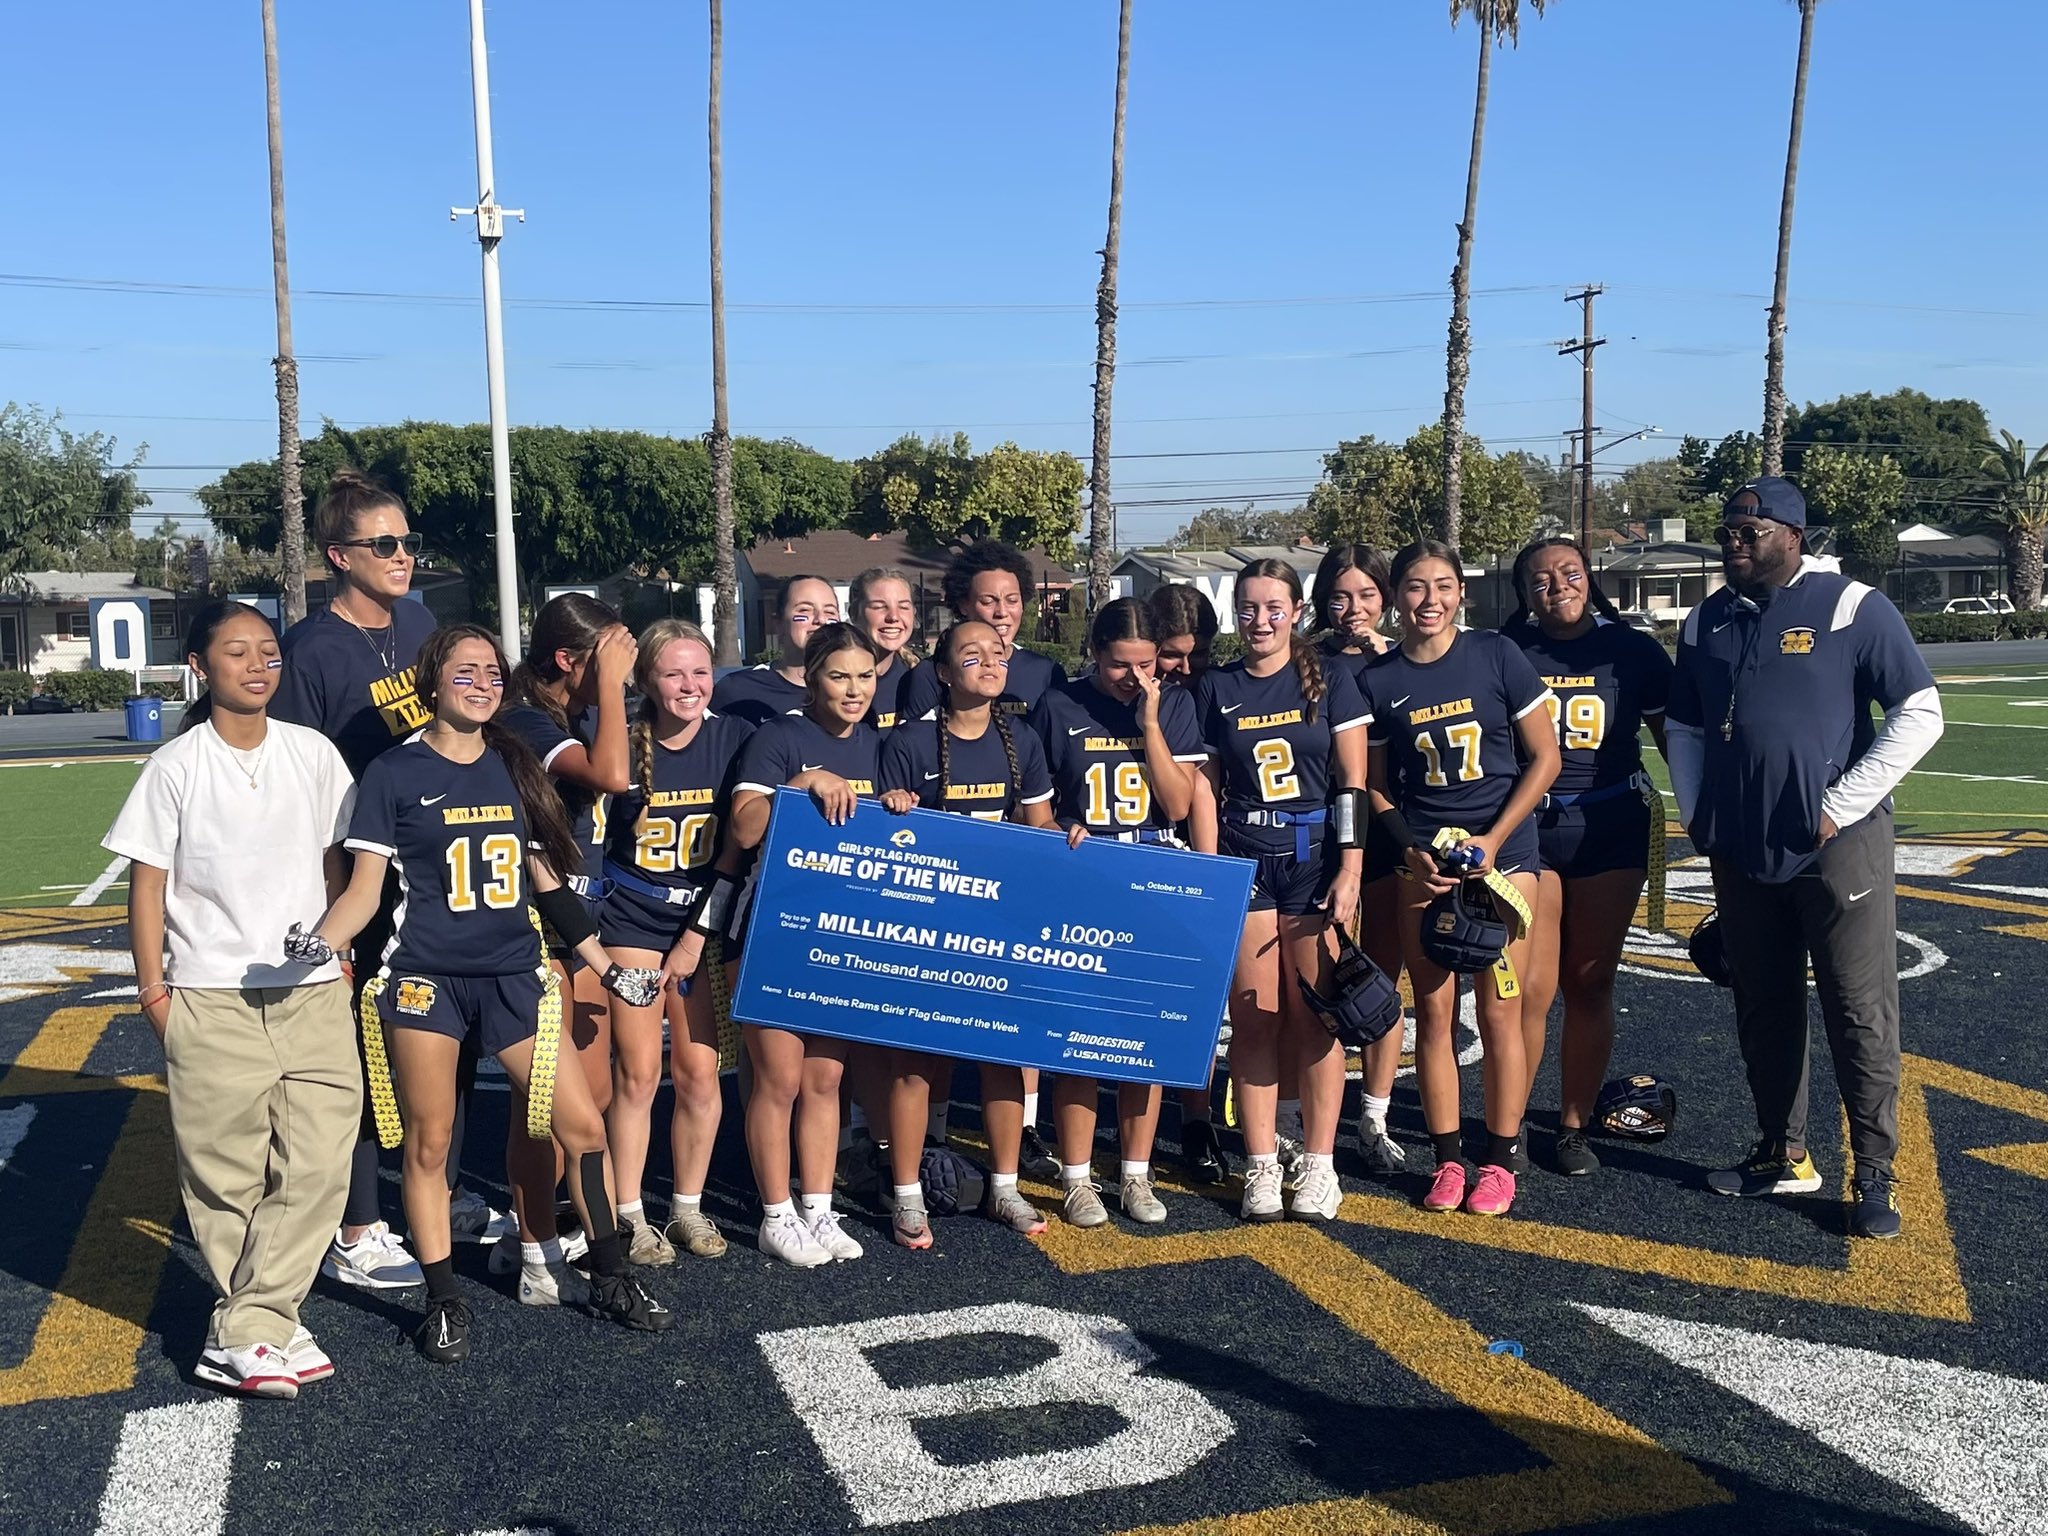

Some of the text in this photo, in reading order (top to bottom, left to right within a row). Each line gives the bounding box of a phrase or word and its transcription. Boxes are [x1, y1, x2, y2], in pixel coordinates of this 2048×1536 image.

[1237, 709, 1302, 731] MILLIKAN
[1409, 698, 1474, 726] MILLIKAN
[1252, 737, 1301, 802] 2
[1414, 720, 1484, 787] 17
[945, 782, 1006, 800] MILLIKAN
[1085, 762, 1150, 825] 19
[442, 805, 514, 825] MILLIKAN
[635, 813, 719, 873] 20
[874, 850, 903, 863] FLAG
[904, 853, 960, 871] FOOTBALL
[446, 834, 521, 913] 13
[787, 847, 1001, 901] GAME OF THE WEEK
[1147, 882, 1176, 893] October
[1185, 887, 1203, 896] 2023
[880, 888, 936, 904] BRIDGESTONE
[817, 911, 1108, 973] MILLIKAN HIGH SCHOOL
[1040, 926, 1052, 942] $
[809, 947, 1009, 992] One Thousand and 00/100
[787, 988, 807, 1000] Los
[808, 991, 850, 1006] Angeles
[851, 998, 880, 1012] Rams
[881, 1003, 908, 1016] Girls'
[908, 1007, 931, 1021] Flag
[932, 1011, 961, 1025] Game
[962, 1016, 975, 1026] of
[974, 1018, 991, 1029] the
[992, 1020, 1020, 1034] Week
[1160, 1010, 1188, 1022] Dollars
[1046, 1029, 1146, 1051] From BRIDGESTONE
[758, 1302, 1237, 1527] B
